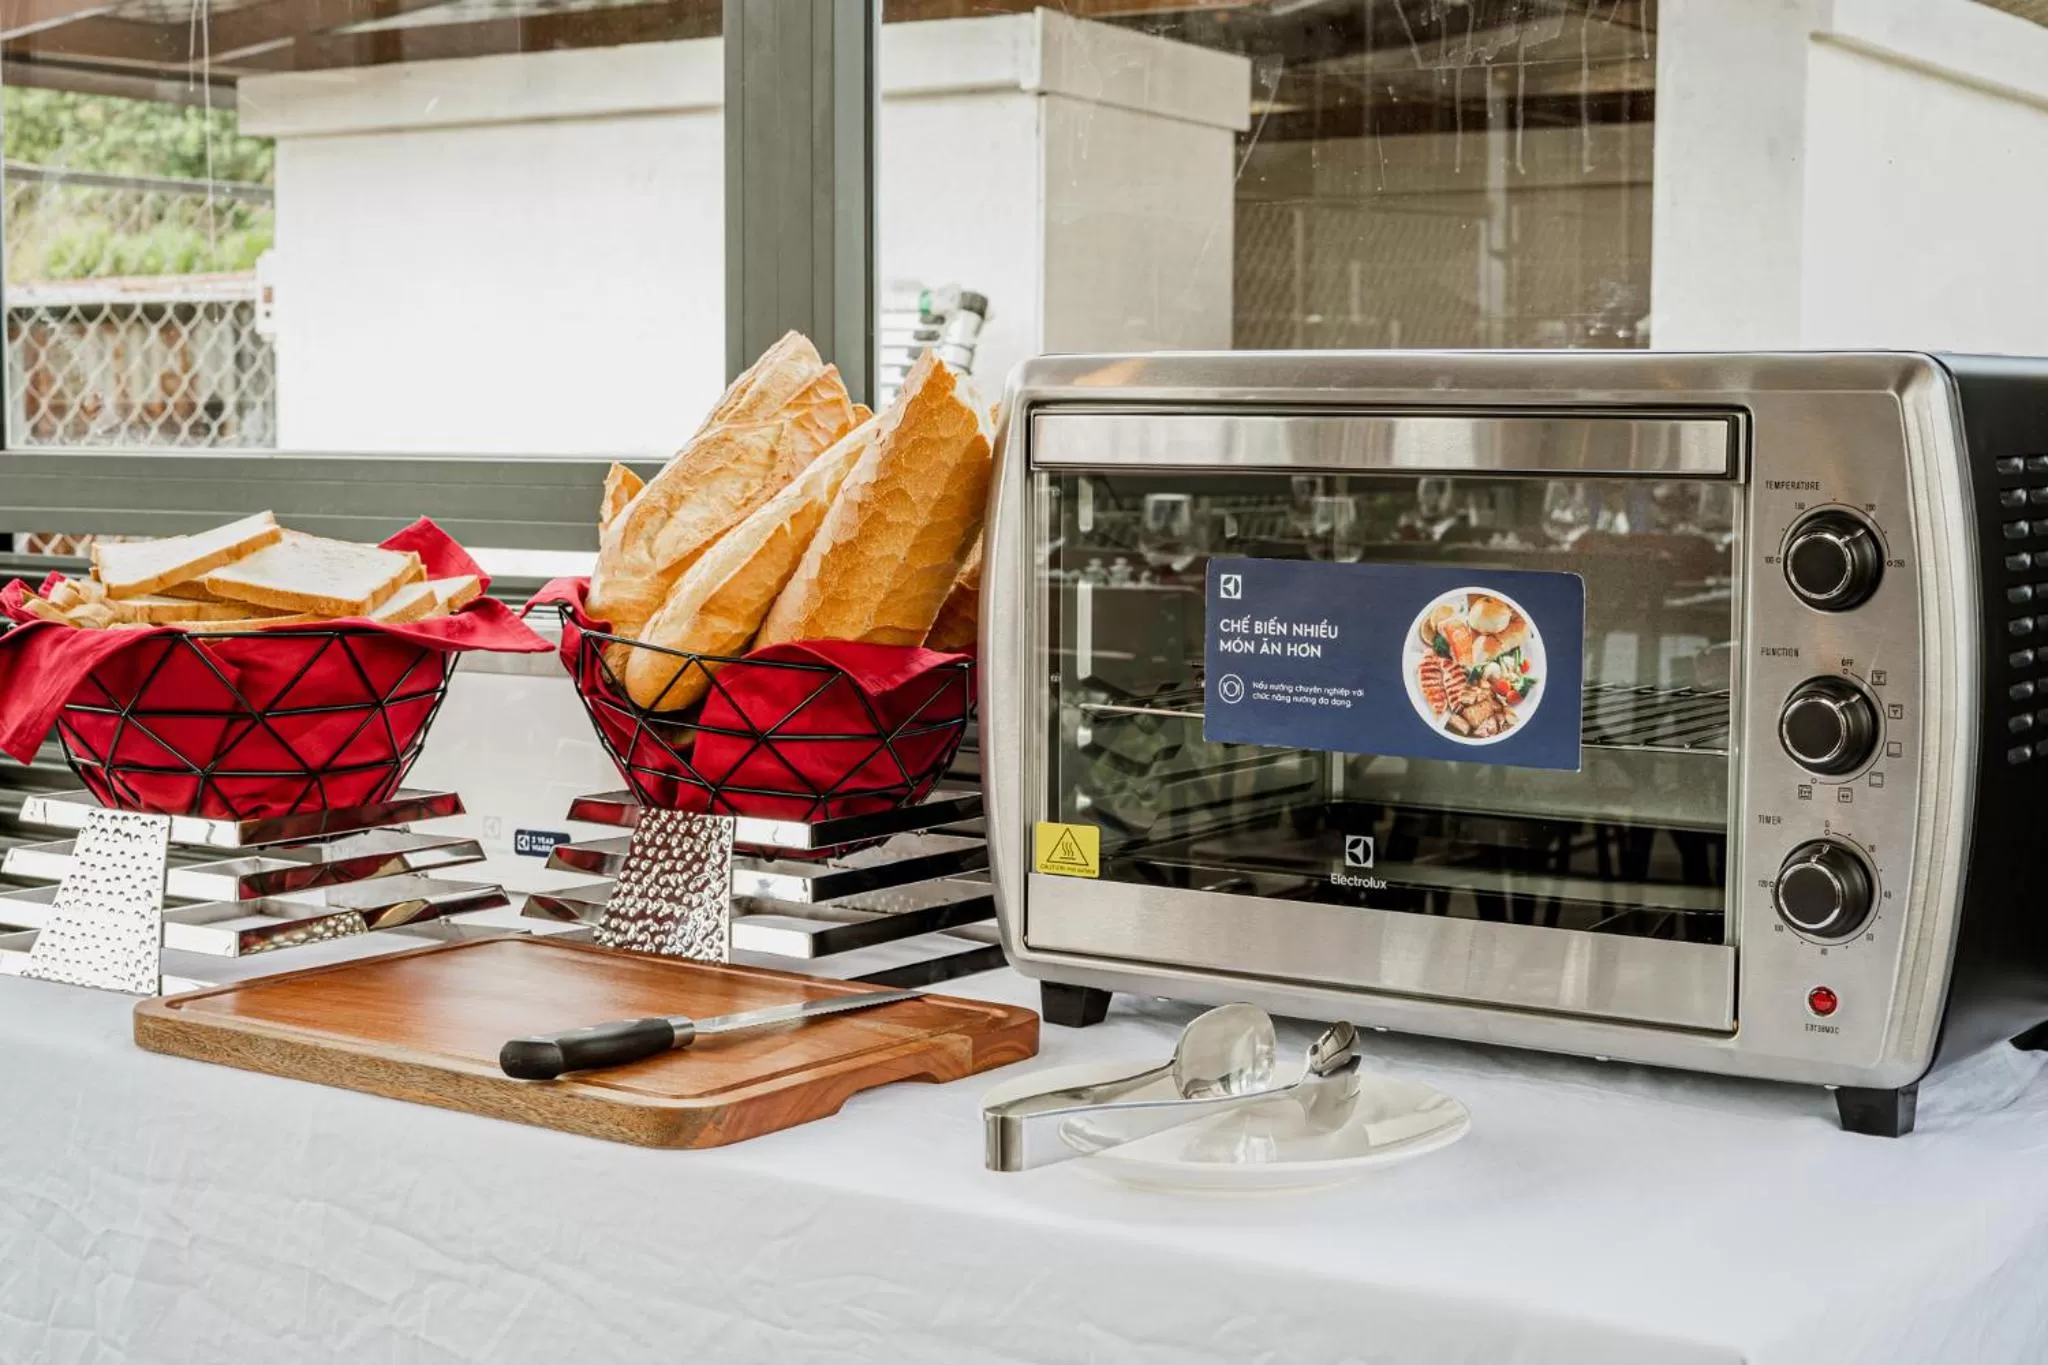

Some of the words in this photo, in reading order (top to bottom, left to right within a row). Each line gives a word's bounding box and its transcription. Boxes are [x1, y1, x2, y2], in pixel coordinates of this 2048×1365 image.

[1765, 480, 1820, 491] TEMPERATURE
[1220, 614, 1251, 634] CHẾ
[1254, 616, 1287, 636] BIẾN
[1220, 637, 1255, 653] MÓN
[1260, 638, 1281, 655] ĂN
[1287, 642, 1321, 658] HƠN
[1760, 647, 1799, 657] FUNCTION
[1758, 814, 1782, 825] TIMER
[1330, 873, 1387, 889] Electrolux
